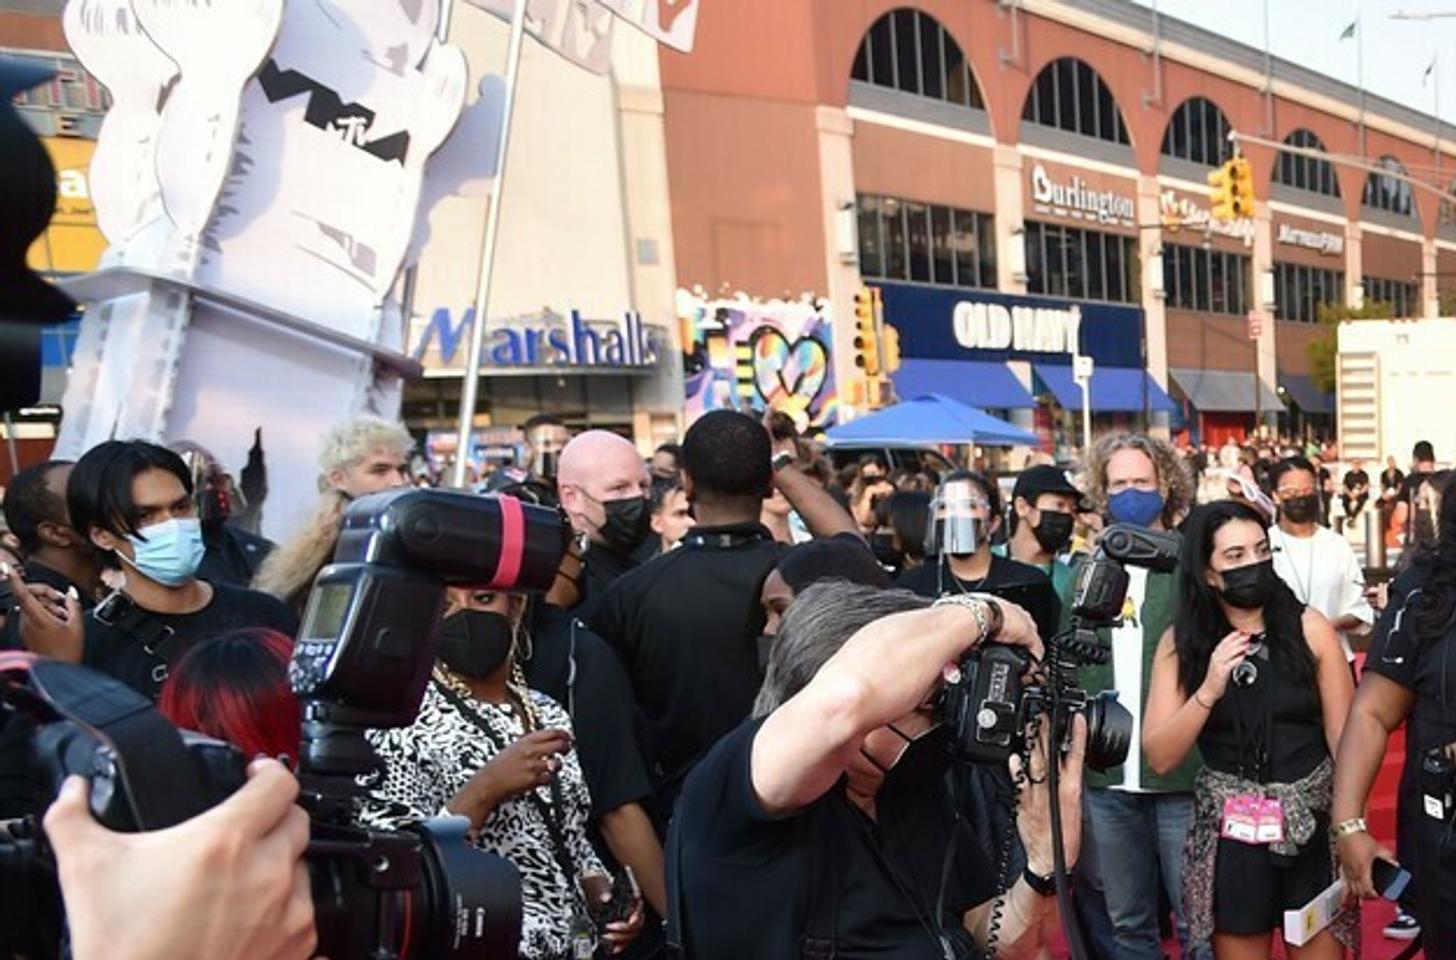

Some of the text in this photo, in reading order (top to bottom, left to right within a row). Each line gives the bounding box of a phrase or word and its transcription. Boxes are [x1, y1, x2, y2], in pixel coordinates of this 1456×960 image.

[1032, 165, 1134, 219] Burlington
[413, 307, 658, 367] Marshalls
[953, 301, 1081, 353] OLD NAVY
